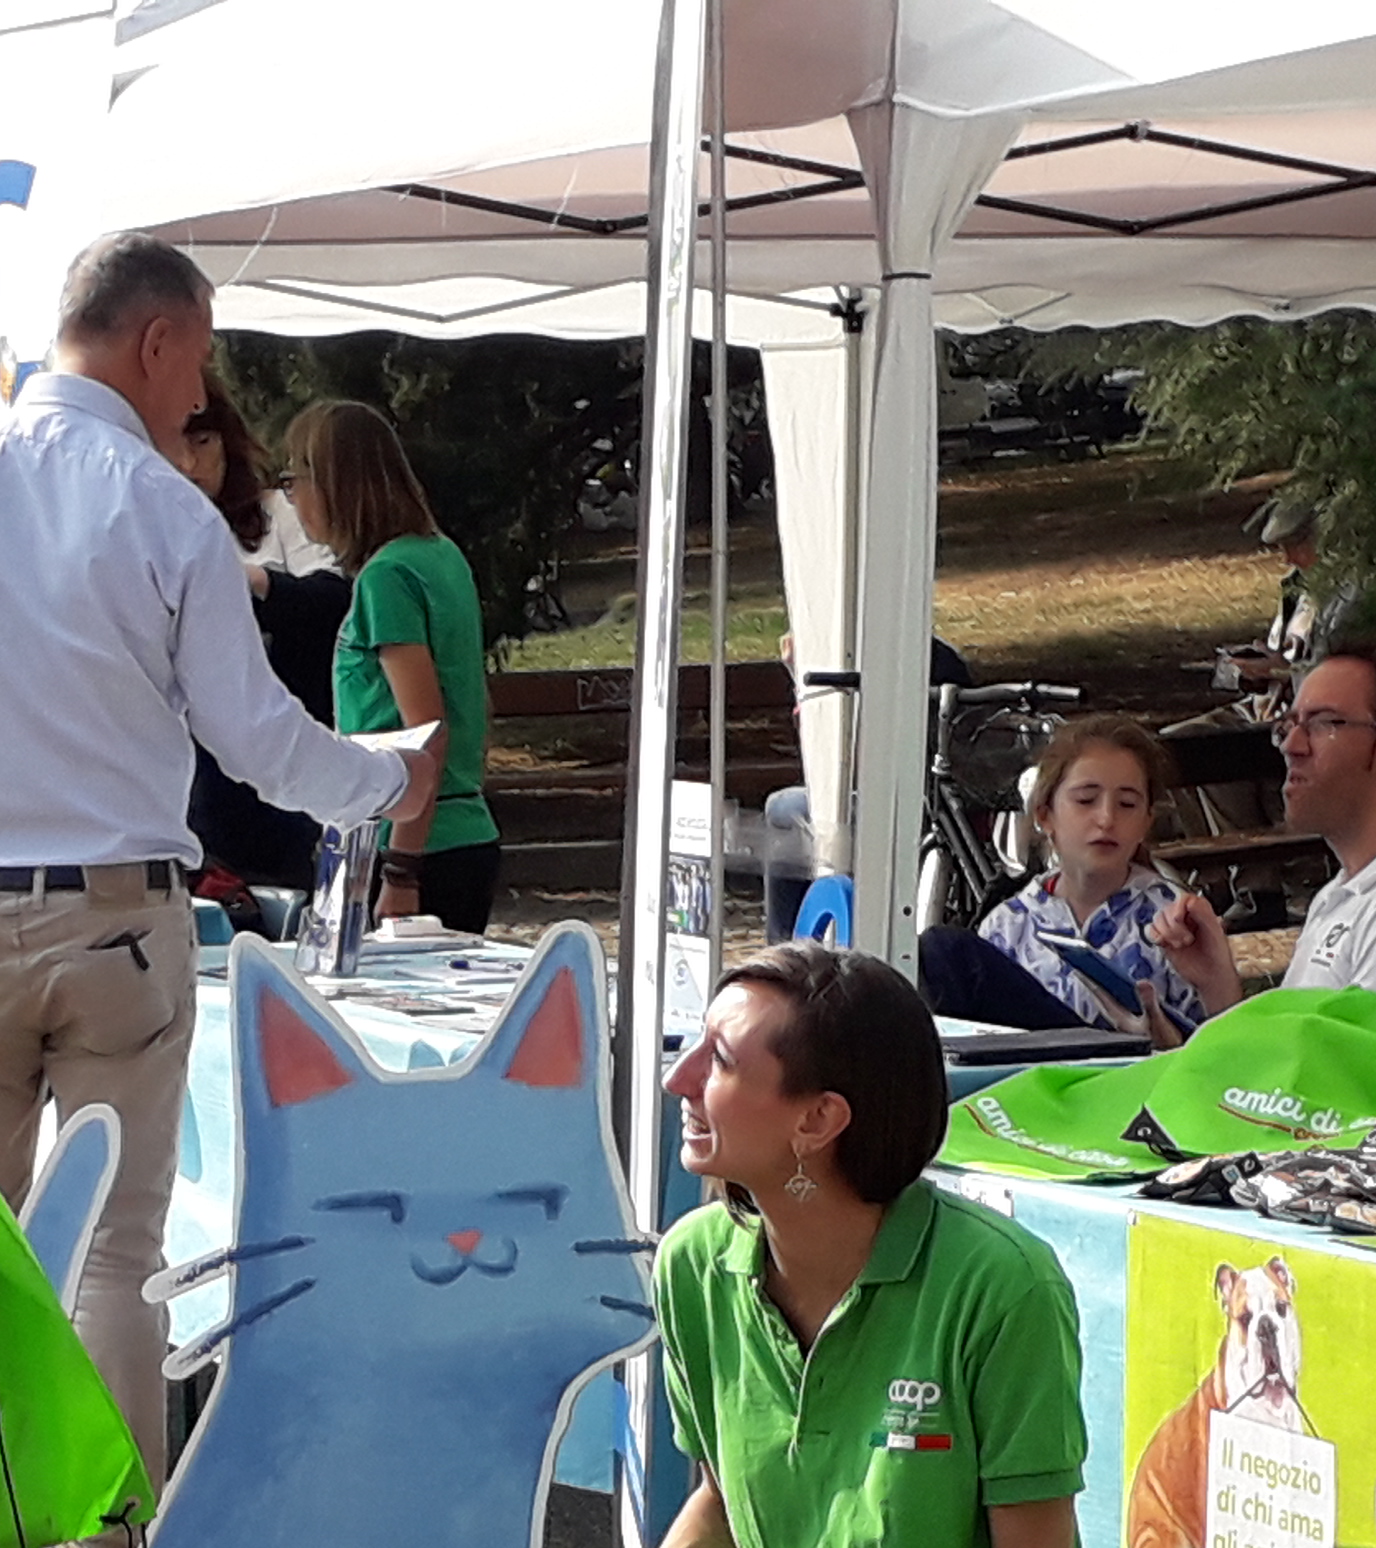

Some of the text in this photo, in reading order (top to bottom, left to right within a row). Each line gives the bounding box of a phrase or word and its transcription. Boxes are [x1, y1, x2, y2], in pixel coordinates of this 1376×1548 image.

[1222, 1438, 1322, 1496] Il negozio
[1217, 1484, 1324, 1542] di chi ama
